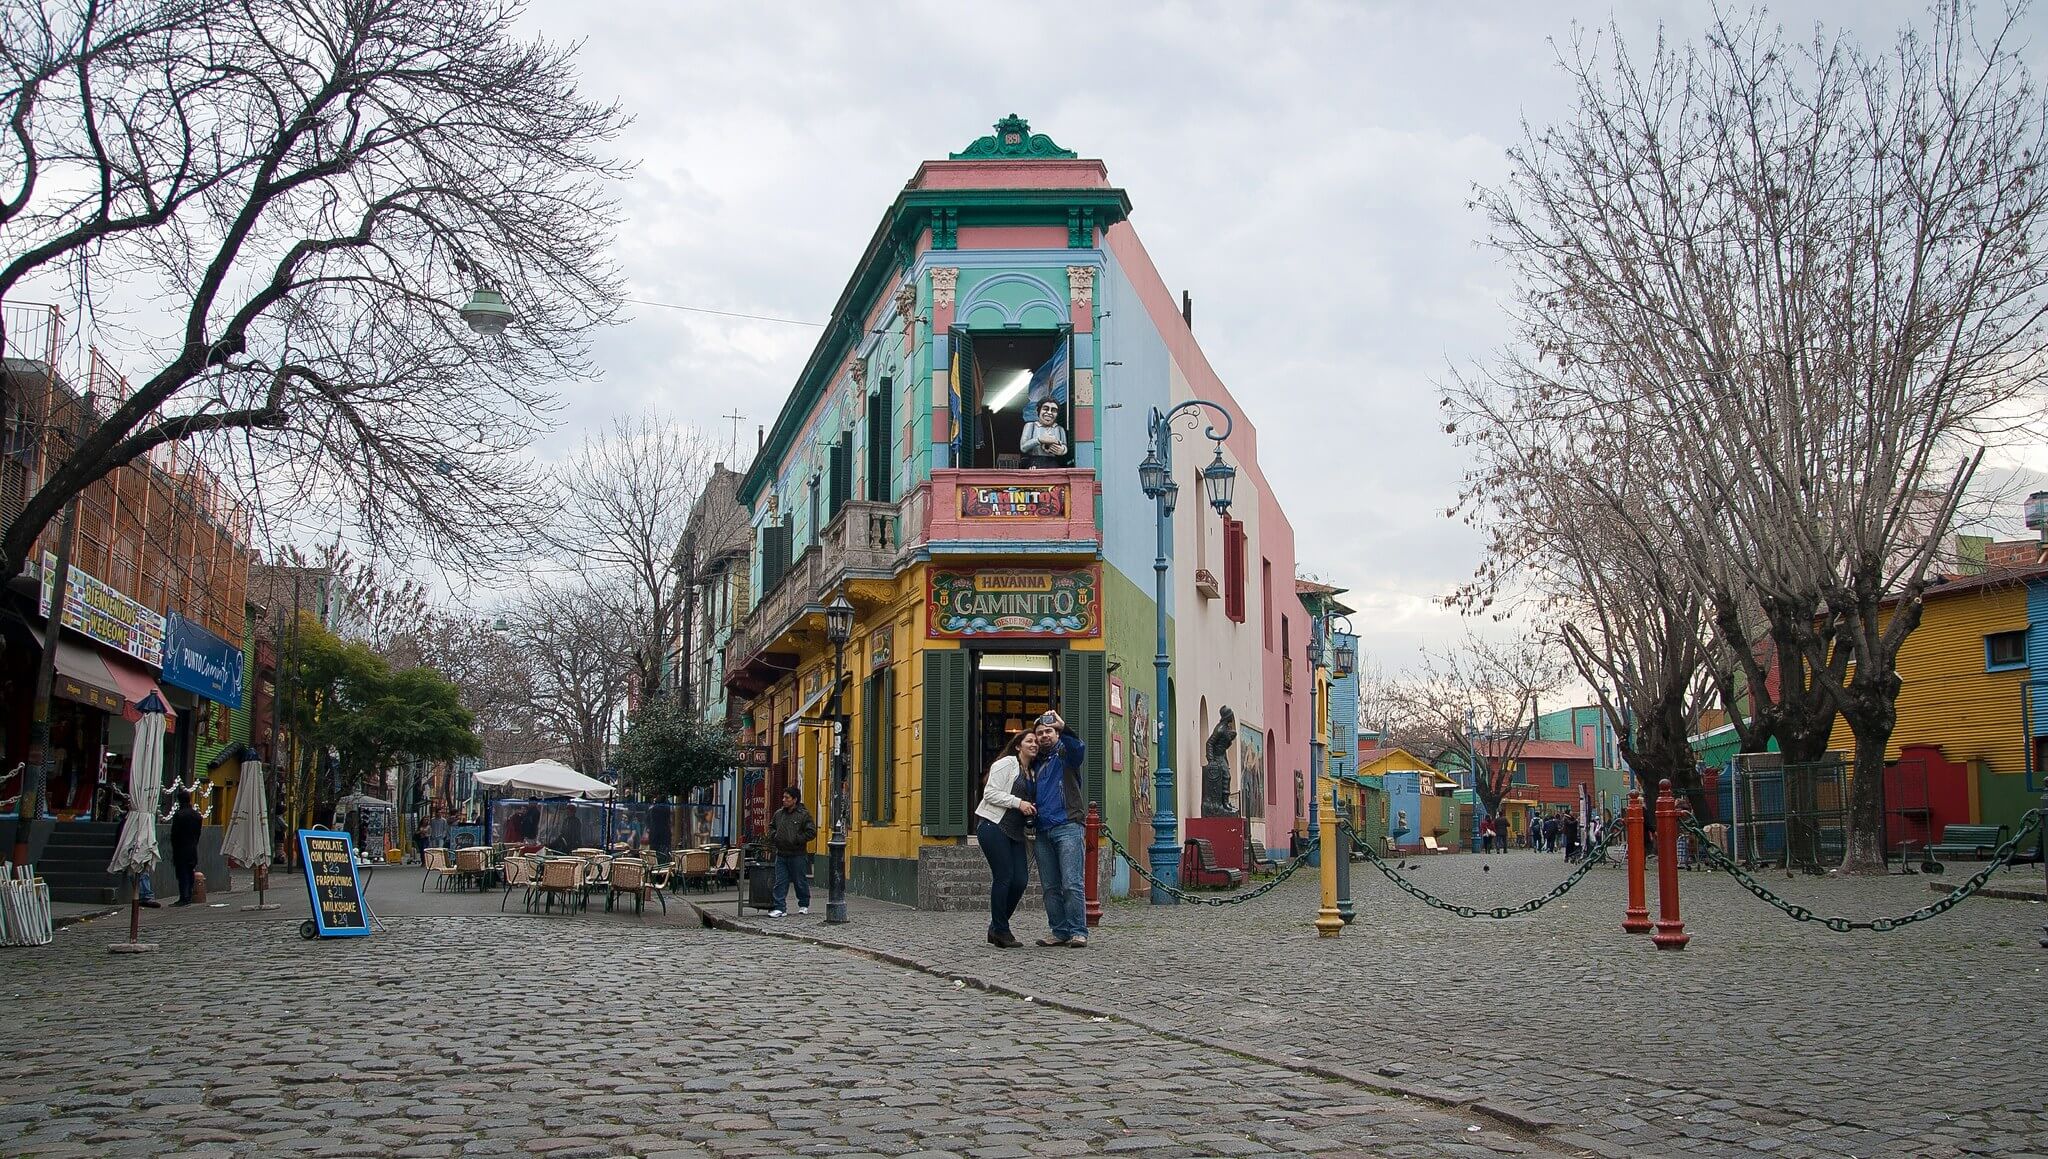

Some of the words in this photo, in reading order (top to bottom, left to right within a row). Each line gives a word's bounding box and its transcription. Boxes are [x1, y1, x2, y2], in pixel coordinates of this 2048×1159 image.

[979, 489, 1051, 503] CAMINITO
[982, 576, 1046, 589] HAVANNA
[84, 585, 137, 625] BIENVENIDOS
[954, 590, 1074, 615] CAMINITO
[89, 613, 129, 646] WELCOME
[184, 648, 203, 673] PUNTO
[312, 840, 343, 851] CHOCOLATE
[311, 851, 323, 862] CON
[325, 852, 348, 863] CHURROS
[323, 901, 356, 912] MILKSHAKE
